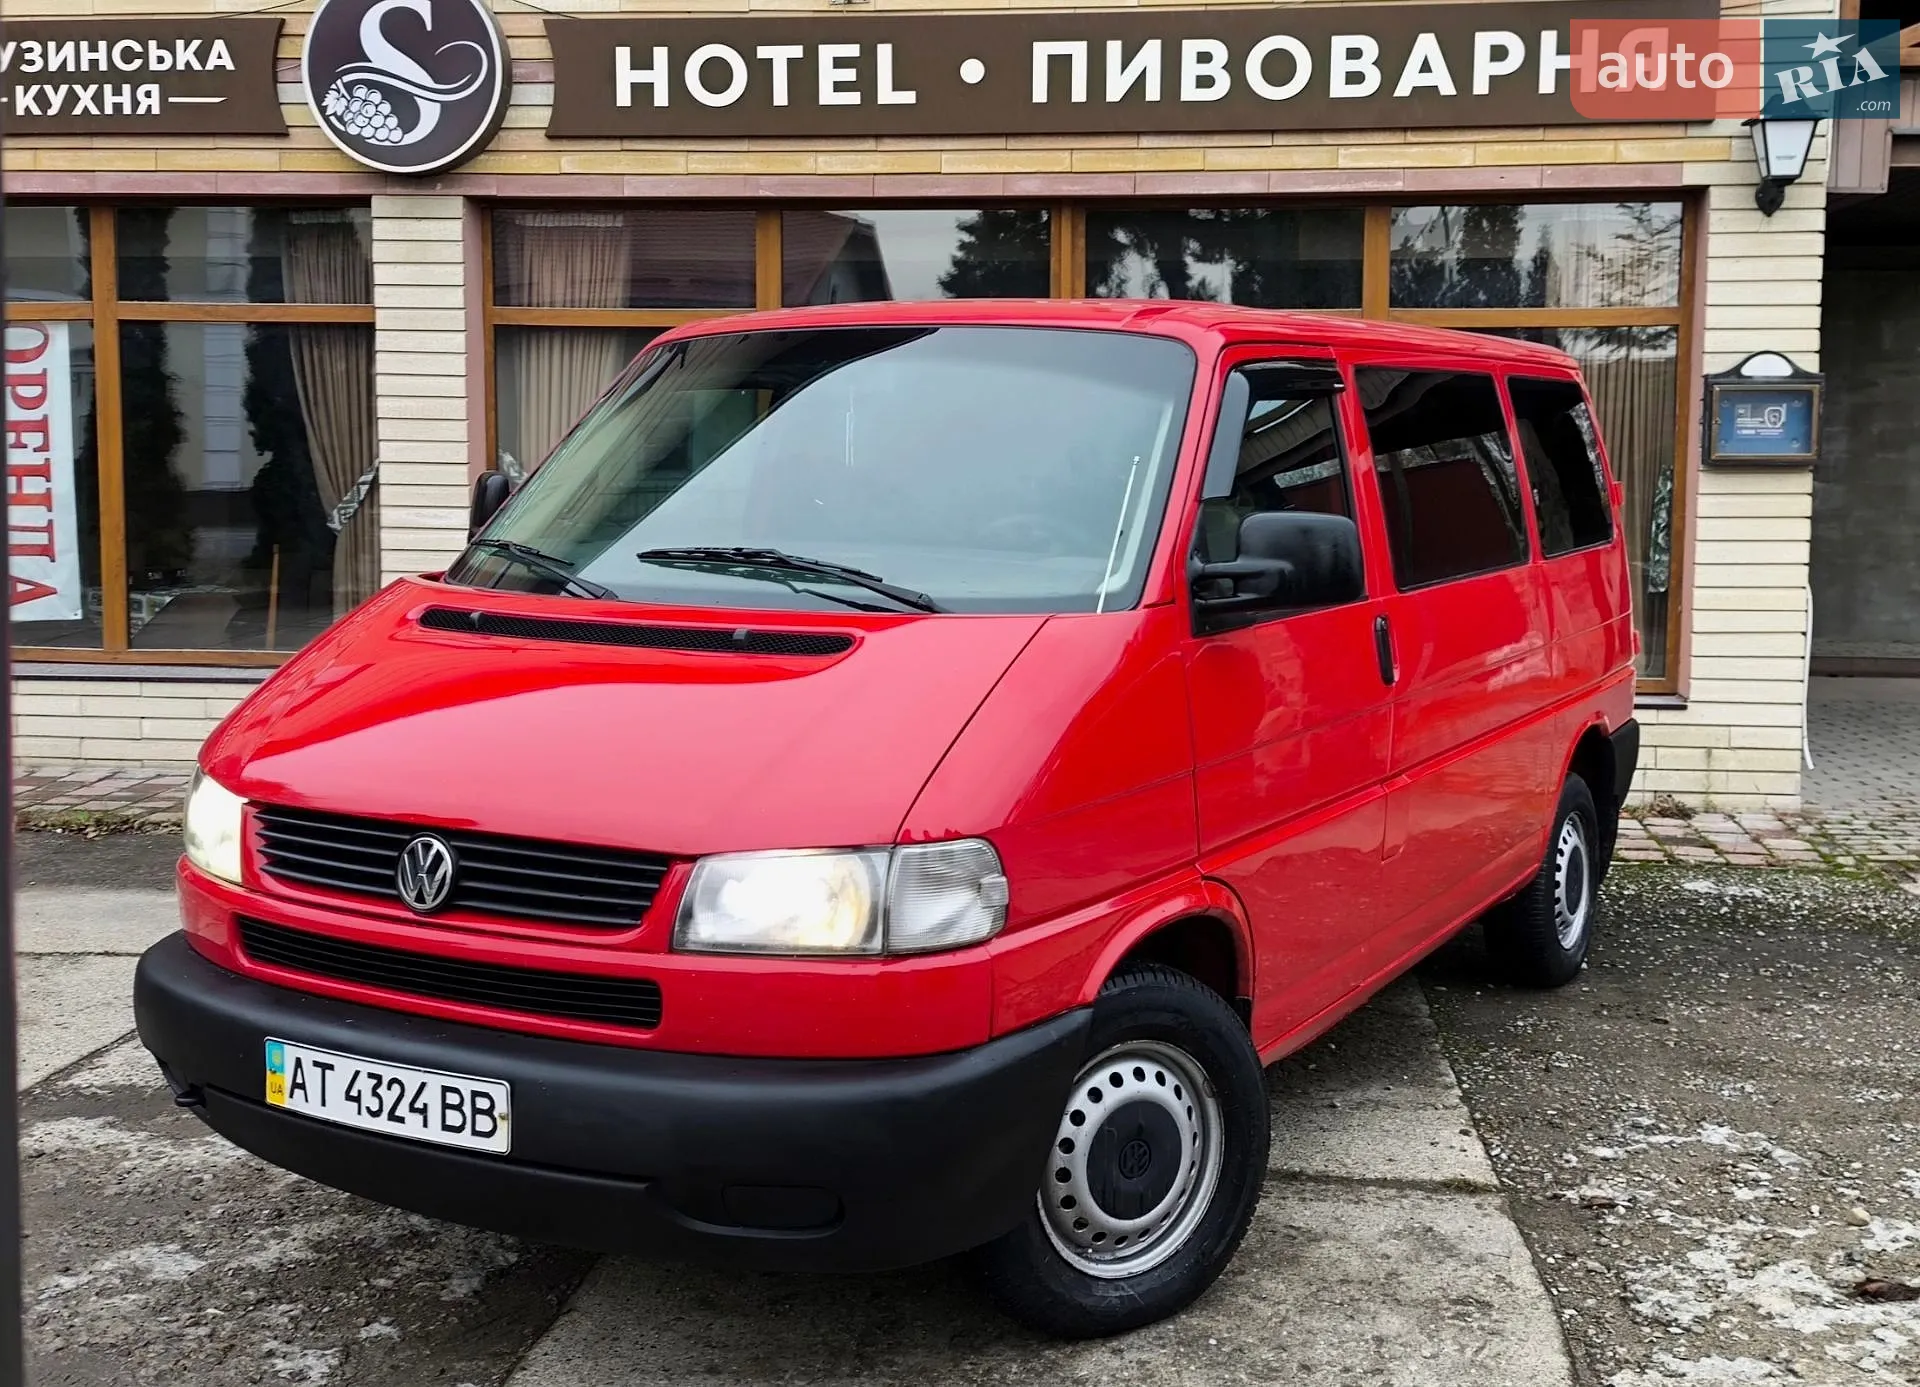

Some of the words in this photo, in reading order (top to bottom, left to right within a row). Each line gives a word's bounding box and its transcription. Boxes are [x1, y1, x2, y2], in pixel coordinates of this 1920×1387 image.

[0, 39, 235, 73] УЗИНСЬКА
[615, 42, 916, 107] HOTEL
[1032, 27, 1669, 104] ПИВОВАРНЯ
[15, 83, 161, 116] КУХНЯ
[270, 1081, 285, 1096] UA
[289, 1056, 335, 1107] AT
[344, 1069, 428, 1129] 4324
[440, 1084, 498, 1139] BB
